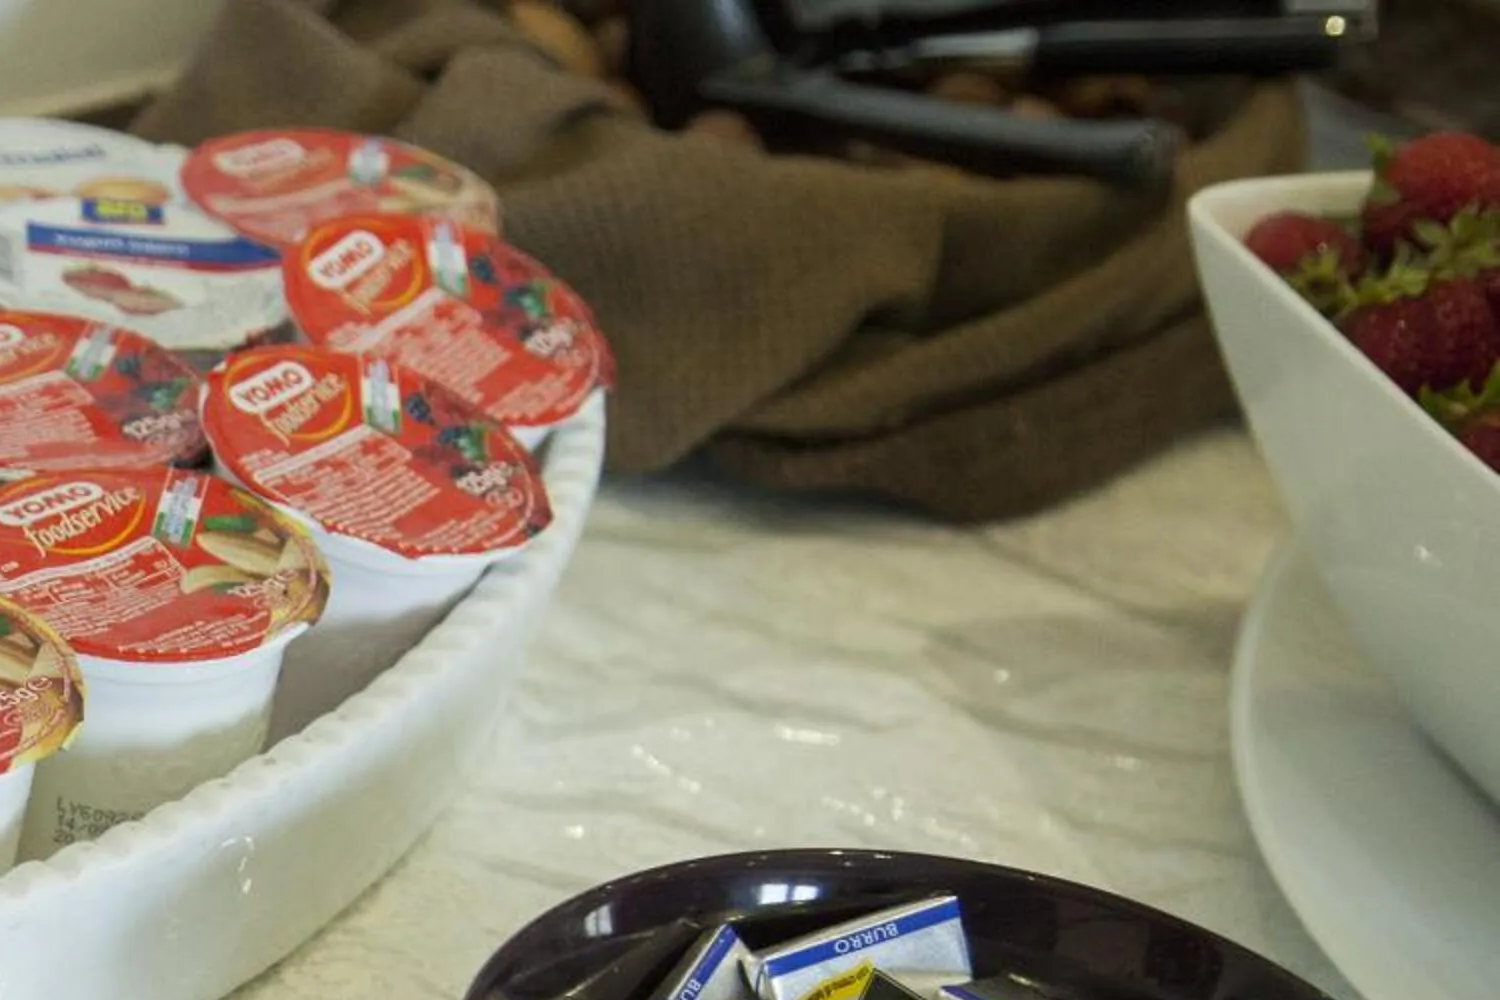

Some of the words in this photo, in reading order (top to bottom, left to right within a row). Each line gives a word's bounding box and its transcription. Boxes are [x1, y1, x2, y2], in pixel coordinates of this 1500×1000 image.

[0, 481, 93, 522] YOMO
[23, 485, 140, 558] foodservice
[834, 922, 899, 954] BURRO
